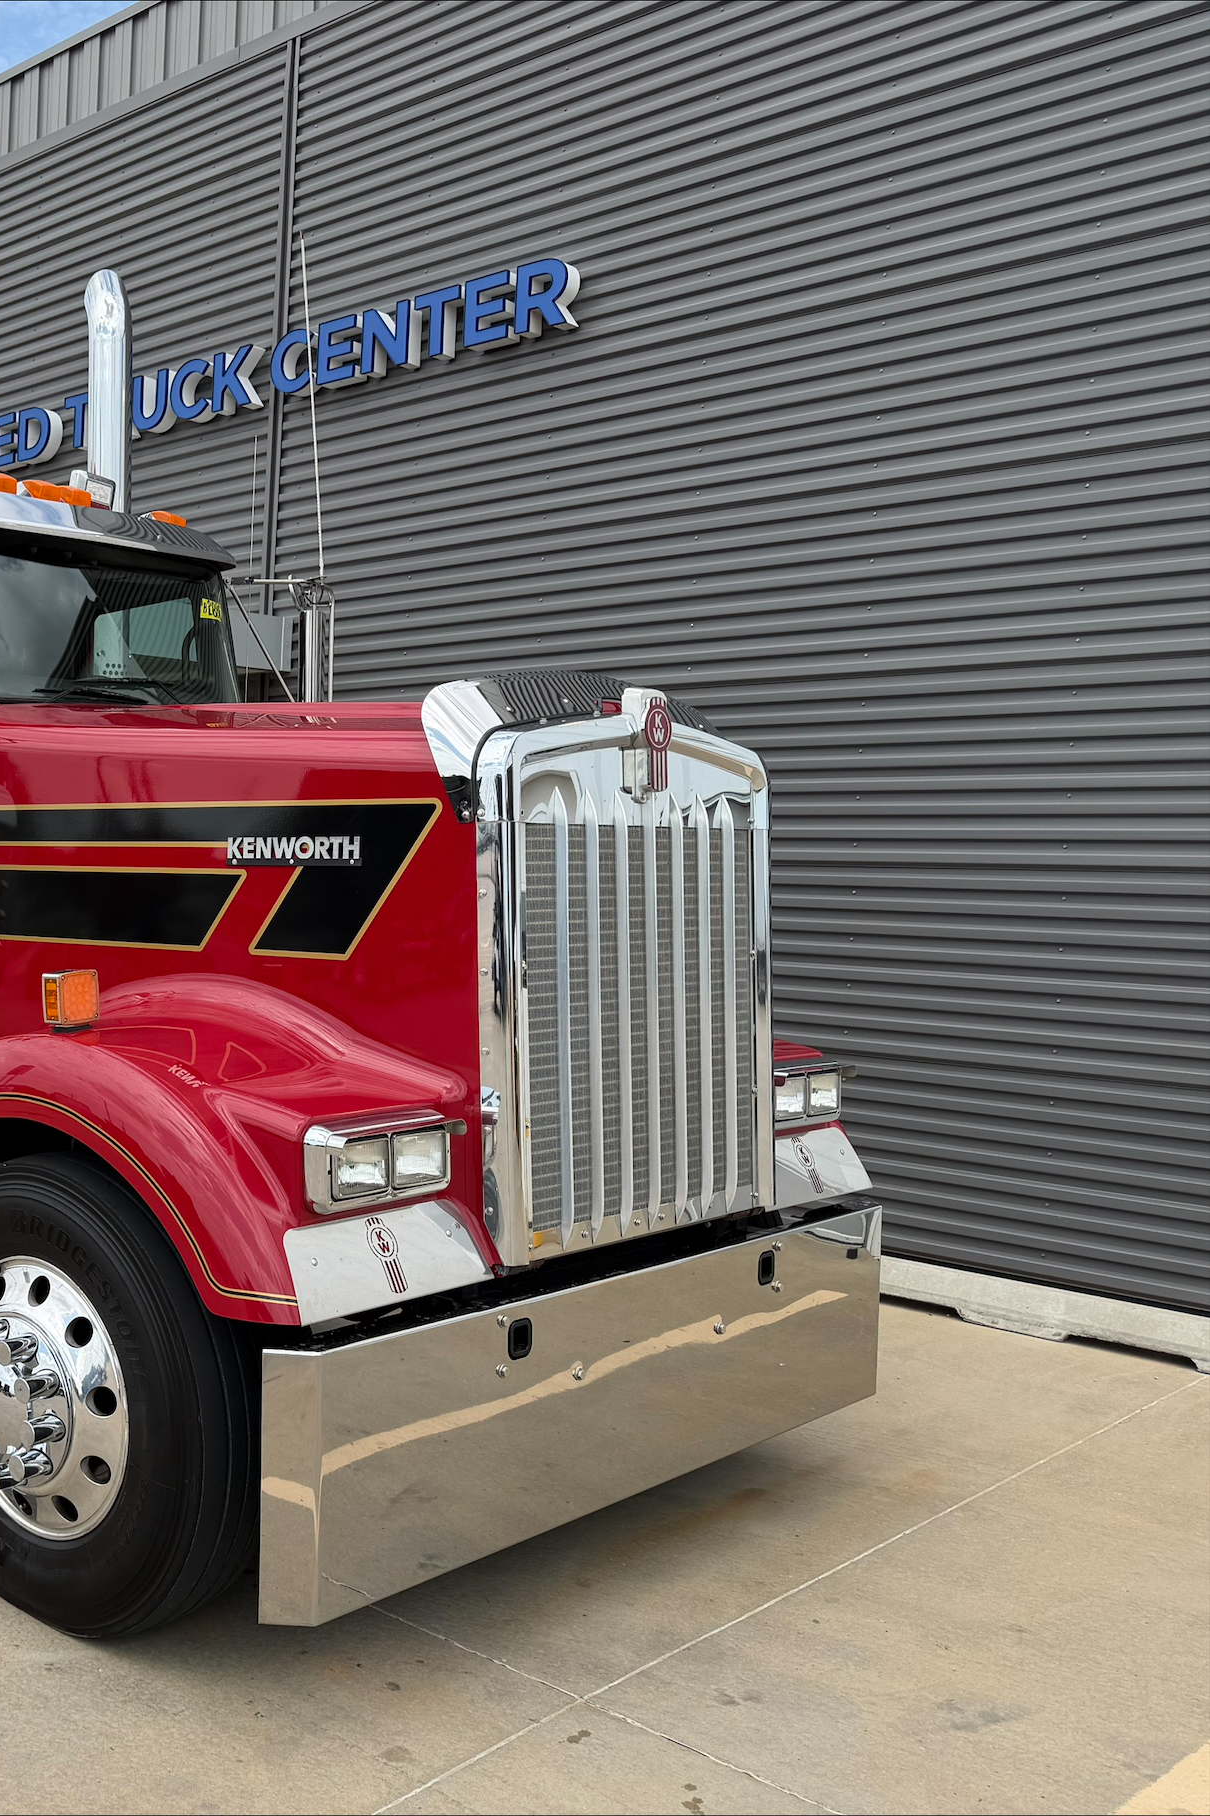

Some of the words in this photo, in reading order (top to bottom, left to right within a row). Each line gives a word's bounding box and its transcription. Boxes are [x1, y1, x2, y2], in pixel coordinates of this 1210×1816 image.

[65, 344, 258, 448] TUCK
[271, 258, 573, 394] CENTER
[227, 836, 360, 859] KENWORTH
[9, 1207, 150, 1396] BRIDGESTONE
